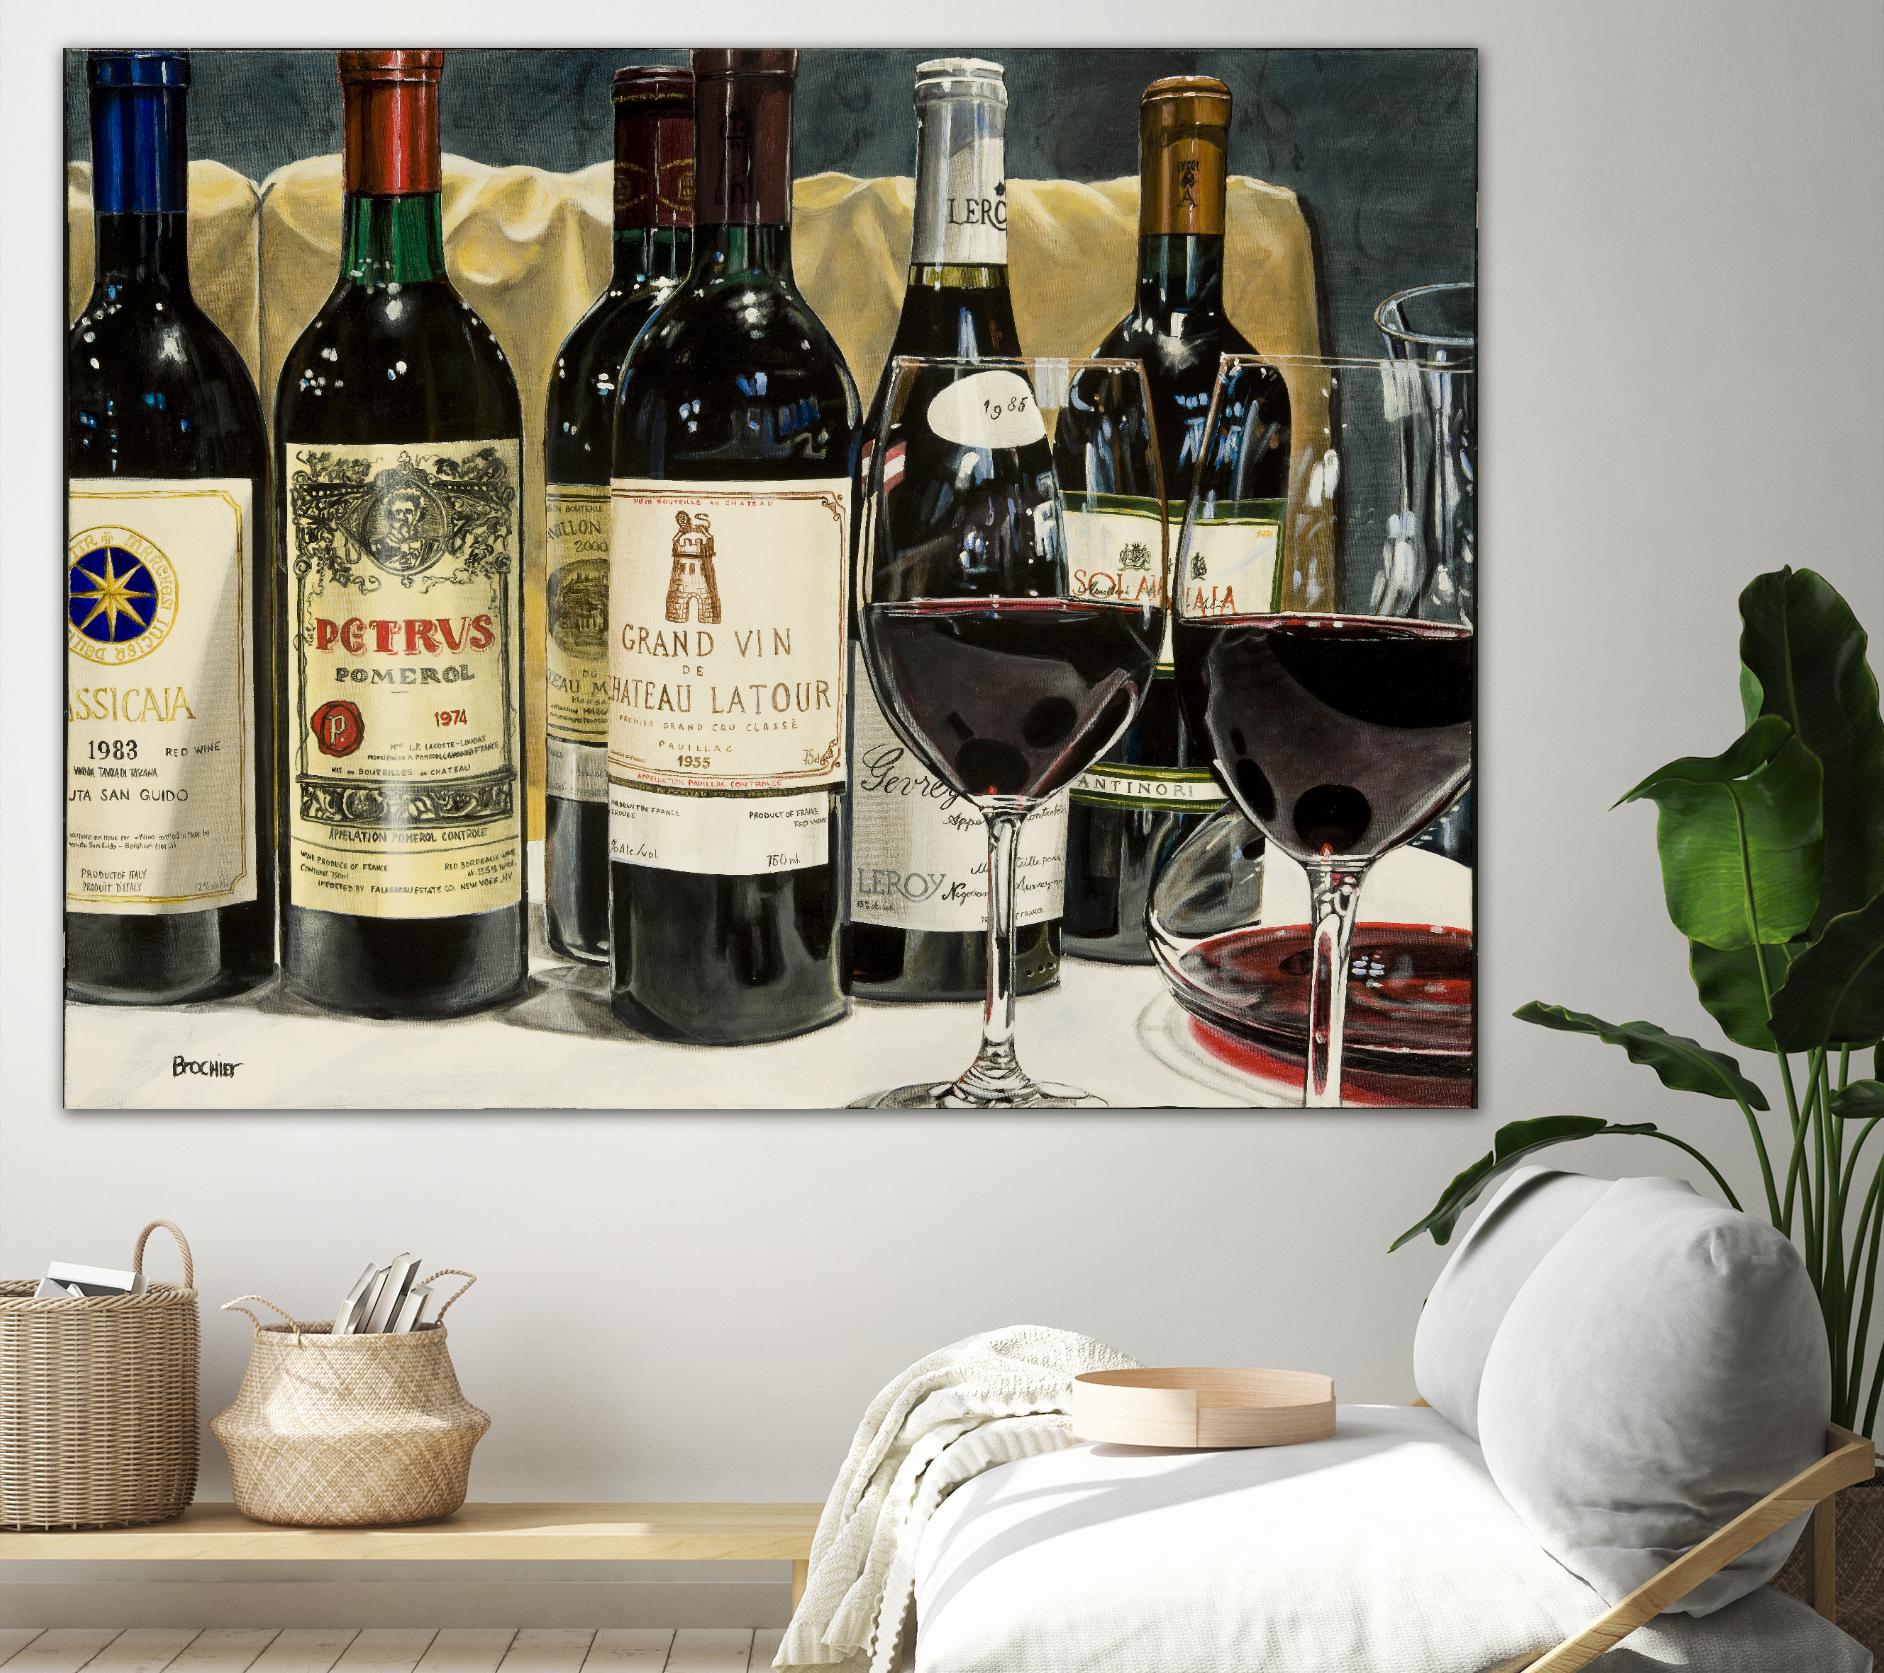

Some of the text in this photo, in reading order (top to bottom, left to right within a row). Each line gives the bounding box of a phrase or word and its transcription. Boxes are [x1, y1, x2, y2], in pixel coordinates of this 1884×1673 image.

[622, 623, 792, 658] GRAND VIN
[335, 663, 475, 685] POMEROL
[682, 665, 704, 677] DE
[608, 675, 832, 715] HATEAU LATOUR
[434, 708, 468, 727] 1974
[663, 722, 704, 731] GRAND
[712, 722, 735, 731] CRU
[88, 739, 138, 760] 1983
[165, 740, 221, 757] RED WINE
[658, 740, 734, 753] PAUILLAC
[677, 755, 711, 769] 1955
[1077, 771, 1194, 797] ANTINORI
[100, 788, 130, 802] SAN
[140, 788, 189, 802] GUIDO
[128, 867, 148, 879] ITALY
[857, 867, 947, 903] LEROY
